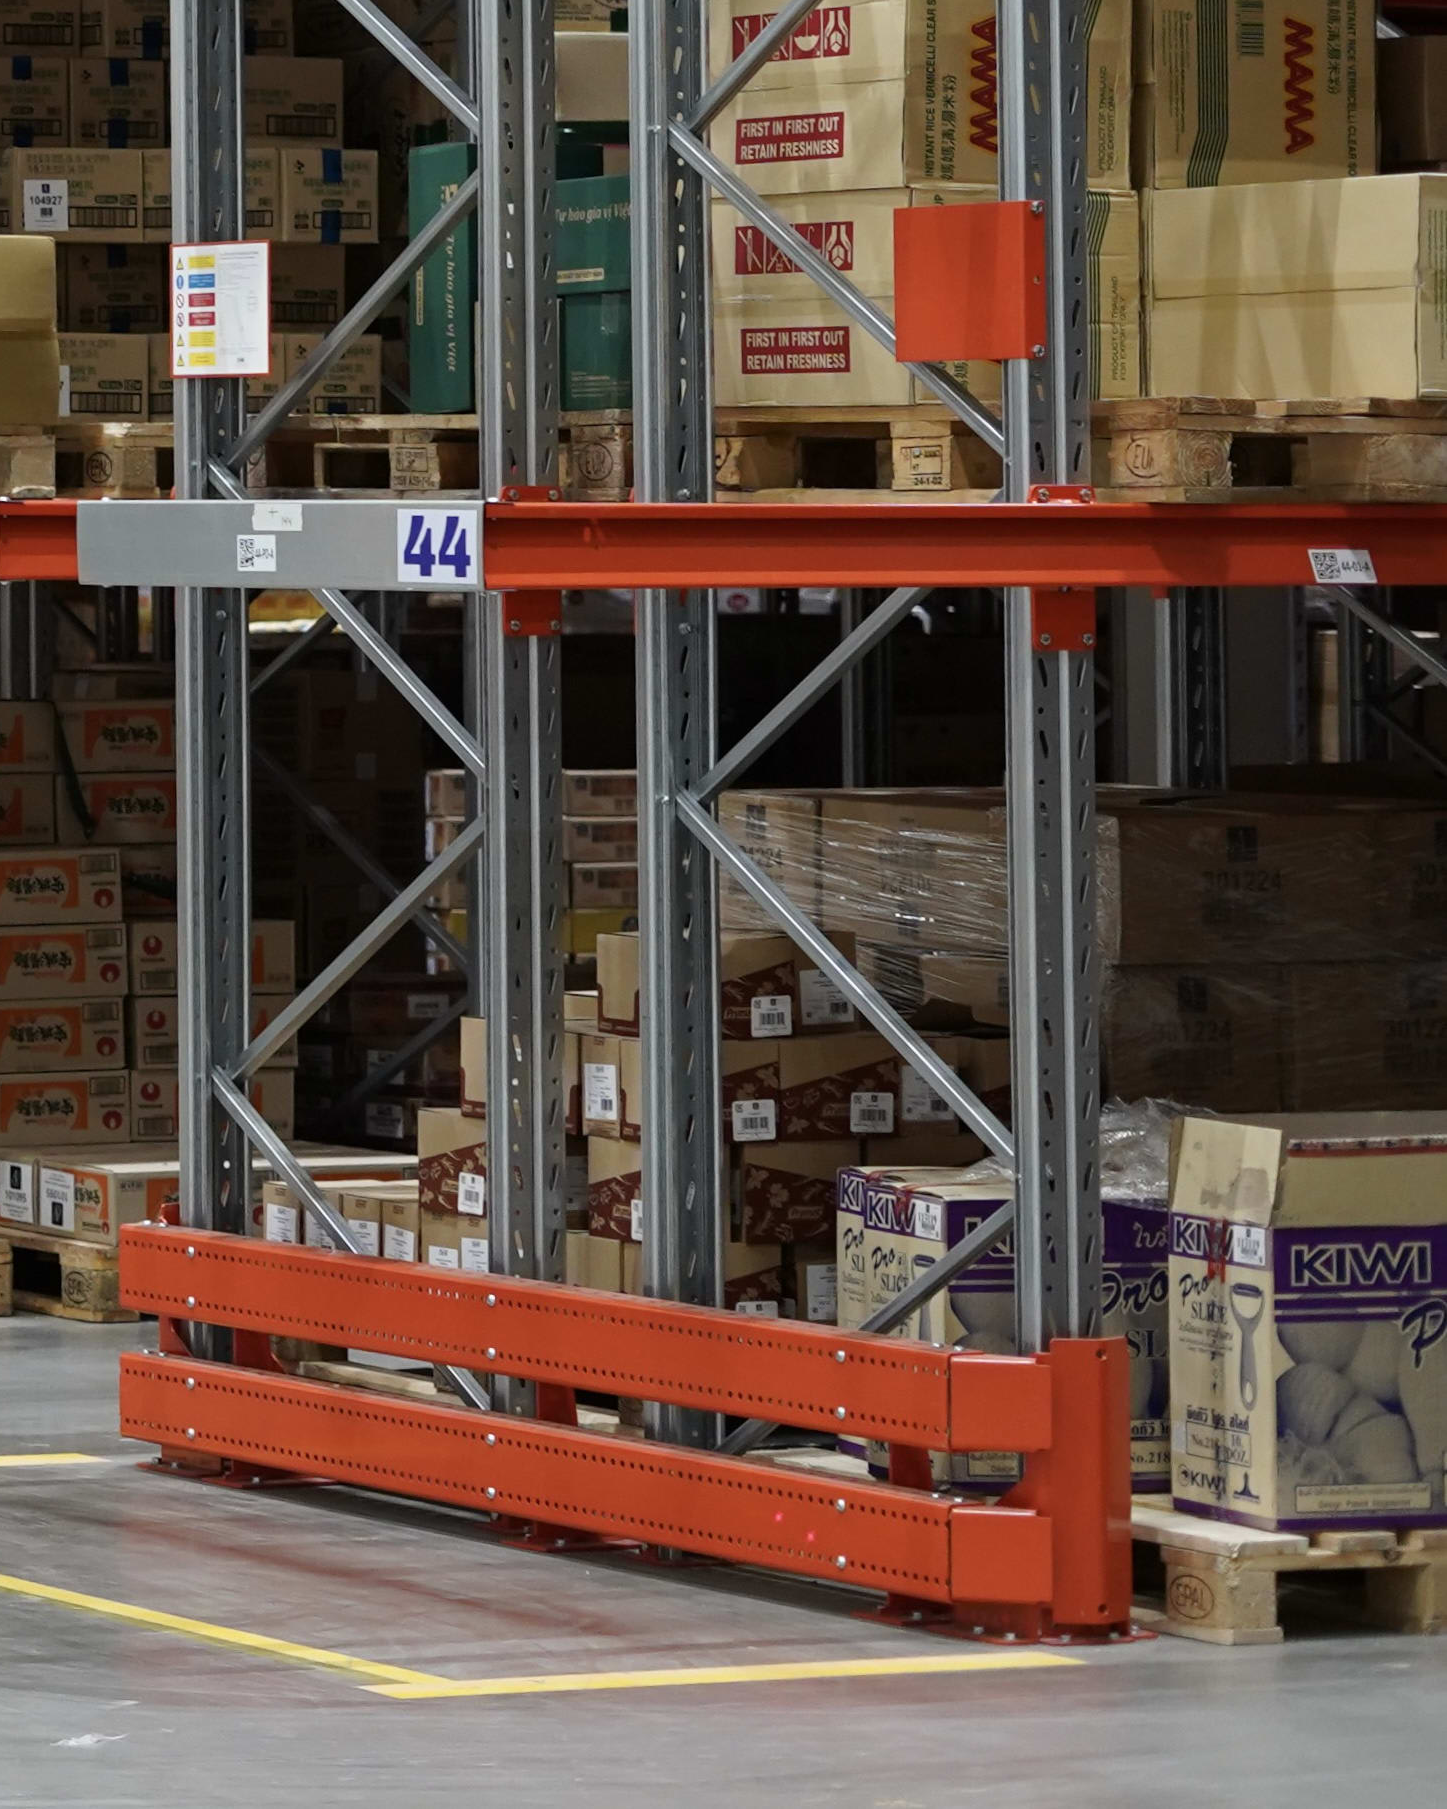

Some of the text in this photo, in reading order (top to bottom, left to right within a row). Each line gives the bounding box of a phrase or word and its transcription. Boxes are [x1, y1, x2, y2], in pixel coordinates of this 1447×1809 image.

[925, 9, 936, 41] CLEAR
[1345, 38, 1357, 61] RICE
[925, 45, 936, 104] VERMICELLI
[970, 16, 997, 154] MAMA
[1283, 18, 1315, 155] MAMA
[1345, 64, 1357, 125] VERMICELLI
[741, 116, 840, 138] FIRST IN FIRST OUT
[925, 108, 936, 131] RICE
[741, 139, 840, 160] RETAIN FRESHNESS
[925, 135, 936, 177] INSTANT
[1345, 125, 1357, 159] CLEAR
[29, 195, 63, 205] 104927
[444, 294, 455, 319] gia
[746, 330, 845, 347] FIRST IN FIRST OUT
[445, 341, 456, 373] Việt
[747, 352, 846, 370] RETAIN FRESHNESS
[403, 515, 471, 577] 44
[871, 1245, 896, 1279] Pro
[1290, 1241, 1432, 1287] KIWI
[1179, 1273, 1210, 1307] Pro
